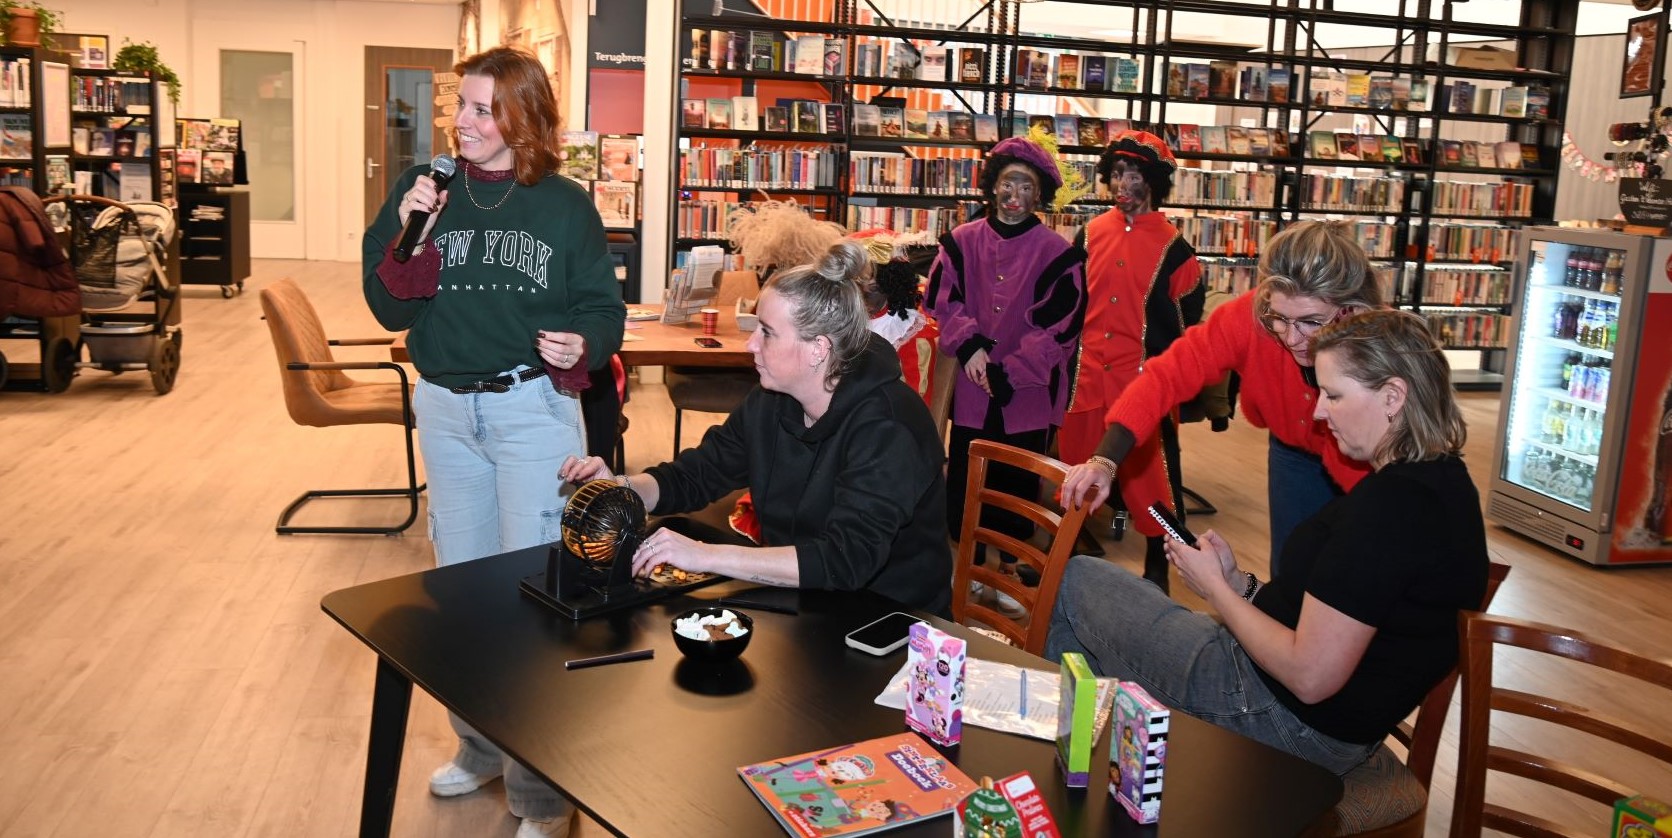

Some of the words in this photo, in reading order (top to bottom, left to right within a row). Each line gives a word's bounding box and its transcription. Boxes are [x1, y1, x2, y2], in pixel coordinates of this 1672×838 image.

[434, 230, 475, 271] EW
[482, 230, 553, 289] YORK
[437, 284, 537, 294] ANHATTAN
[890, 752, 934, 790] Doeboek
